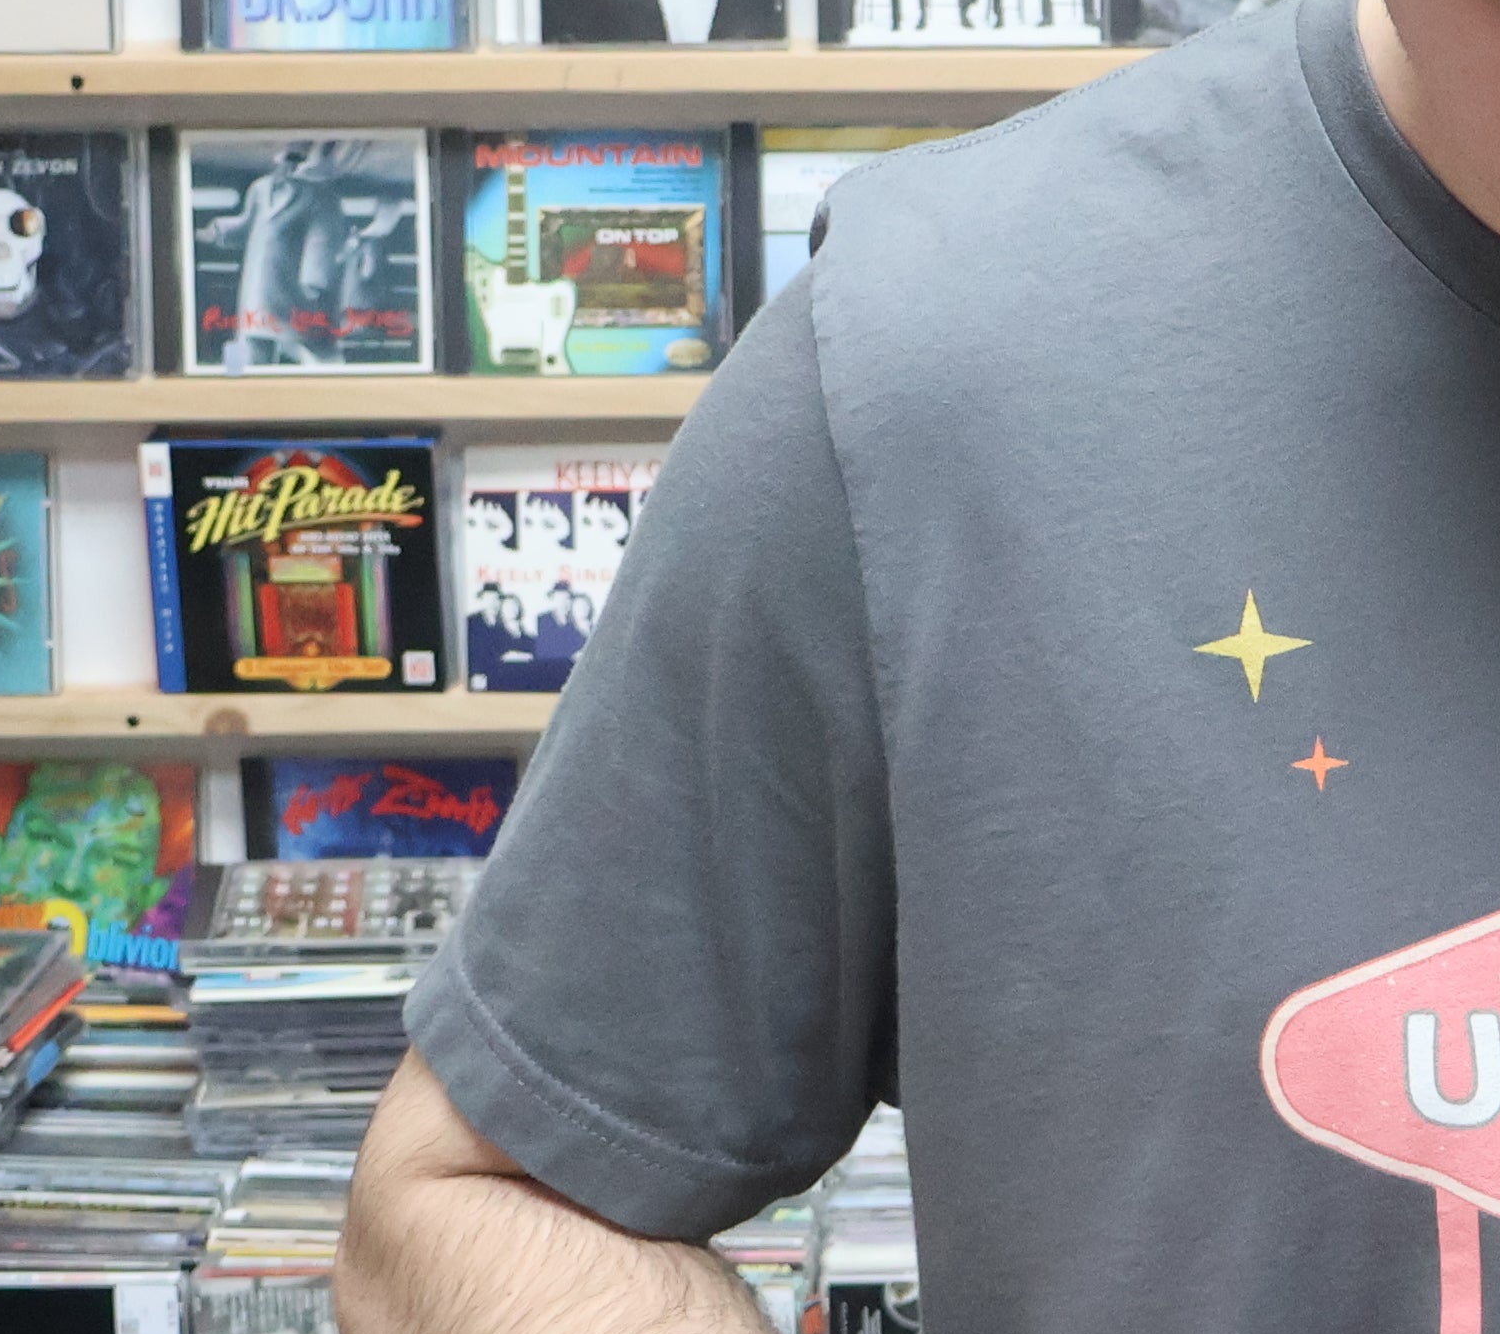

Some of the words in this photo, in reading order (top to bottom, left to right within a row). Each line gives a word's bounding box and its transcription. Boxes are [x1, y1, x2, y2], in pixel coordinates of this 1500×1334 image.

[474, 142, 703, 169] MOUNTAIN
[595, 227, 629, 244] ON
[632, 227, 679, 244] TOP
[190, 489, 262, 553] Hit
[260, 466, 426, 545] Parade
[478, 564, 546, 584] KEELY
[556, 563, 614, 584] SING
